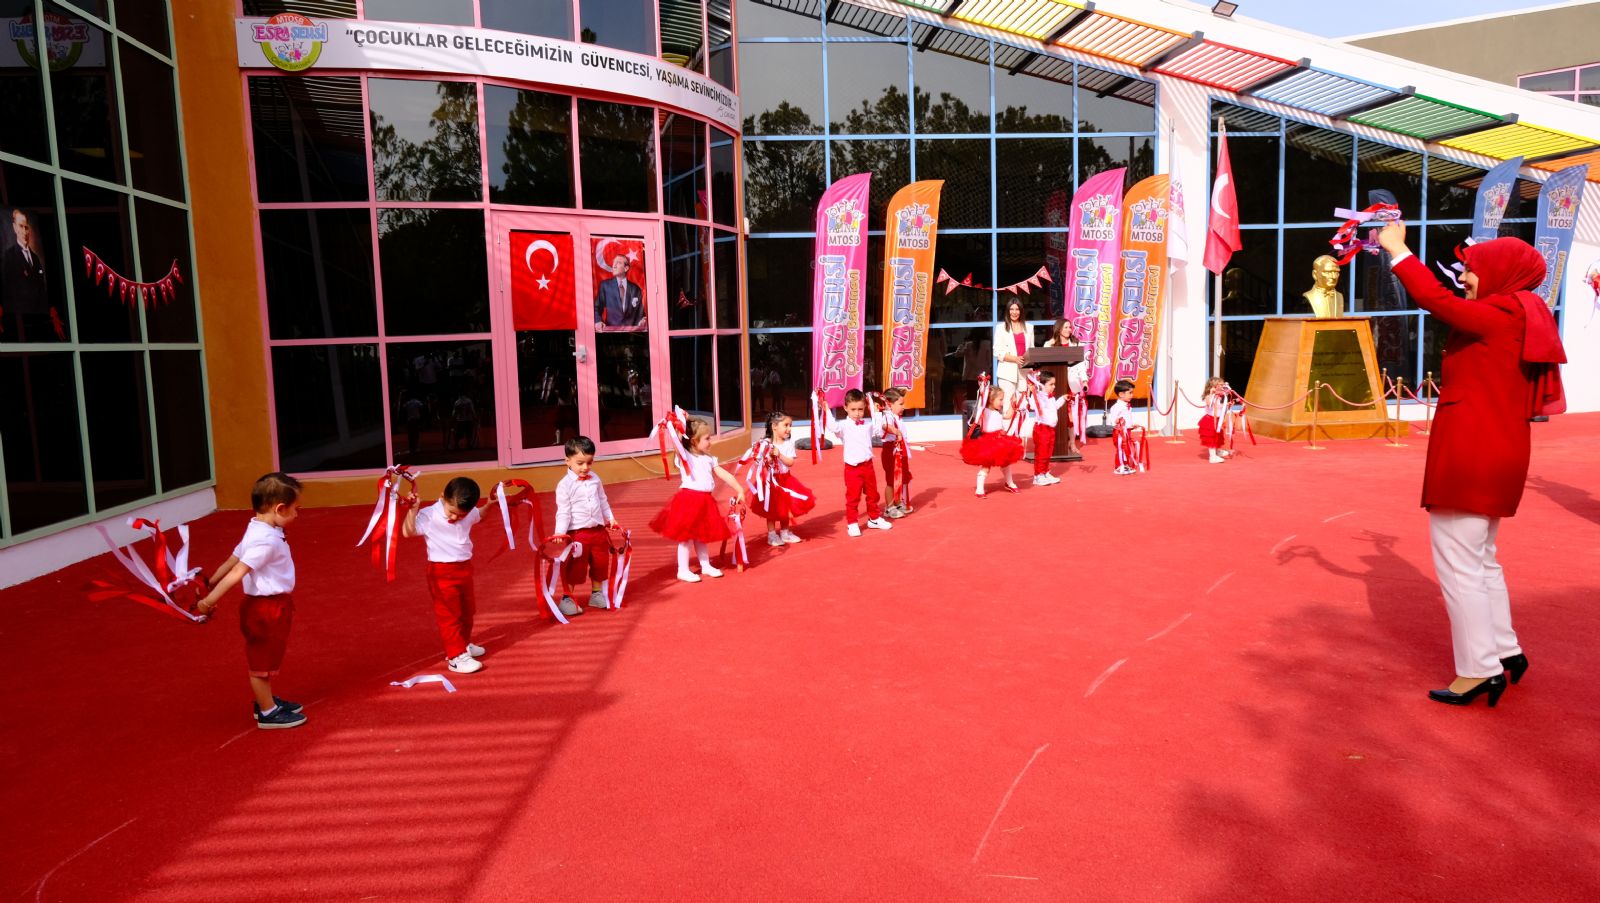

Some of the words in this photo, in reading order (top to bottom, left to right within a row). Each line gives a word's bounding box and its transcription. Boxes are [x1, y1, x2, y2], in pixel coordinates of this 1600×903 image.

[254, 25, 290, 41] ESRA
[453, 35, 573, 64] GELECEĞİMİZİN
[581, 52, 653, 81] GÜVENCESİ,
[656, 68, 690, 91] YAŞAMA
[828, 234, 860, 245] MTOSB
[1082, 229, 1114, 239] MTOSB
[1131, 231, 1163, 241] MTOSB
[899, 238, 929, 248] MTOSB
[1117, 317, 1144, 381] ESRA
[823, 325, 847, 390] ESRA
[891, 326, 914, 390] ESRA
